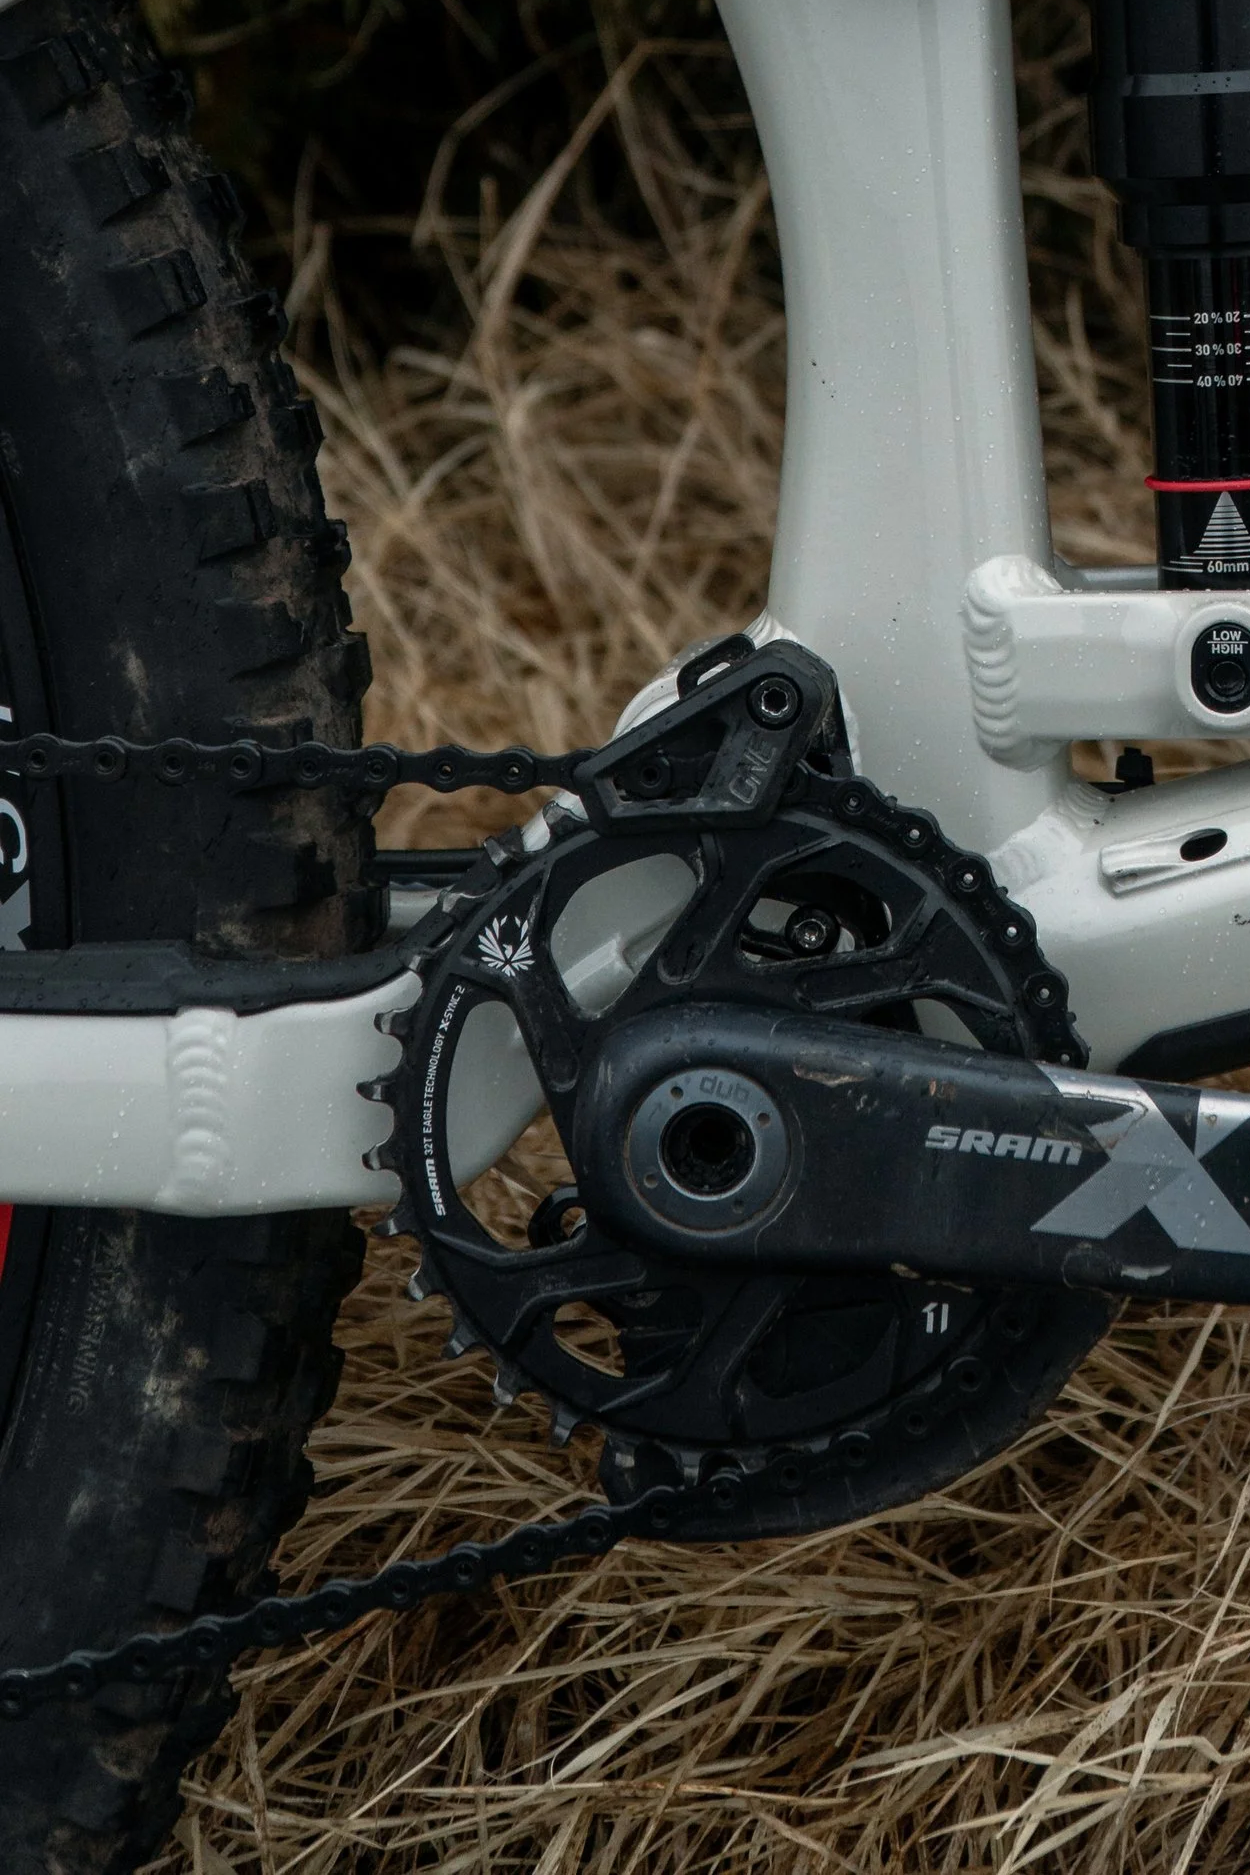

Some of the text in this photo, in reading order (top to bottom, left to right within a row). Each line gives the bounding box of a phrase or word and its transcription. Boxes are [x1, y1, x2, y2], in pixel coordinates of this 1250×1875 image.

[1207, 560, 1250, 573] 60mm
[1212, 630, 1242, 641] LOW
[1211, 644, 1243, 655] HIGH
[699, 1075, 750, 1104] dub
[422, 984, 466, 1217] SRAM 32T EAGLE TECHNOLOGY X-SYNC 2
[925, 1125, 1082, 1166] SRAM
